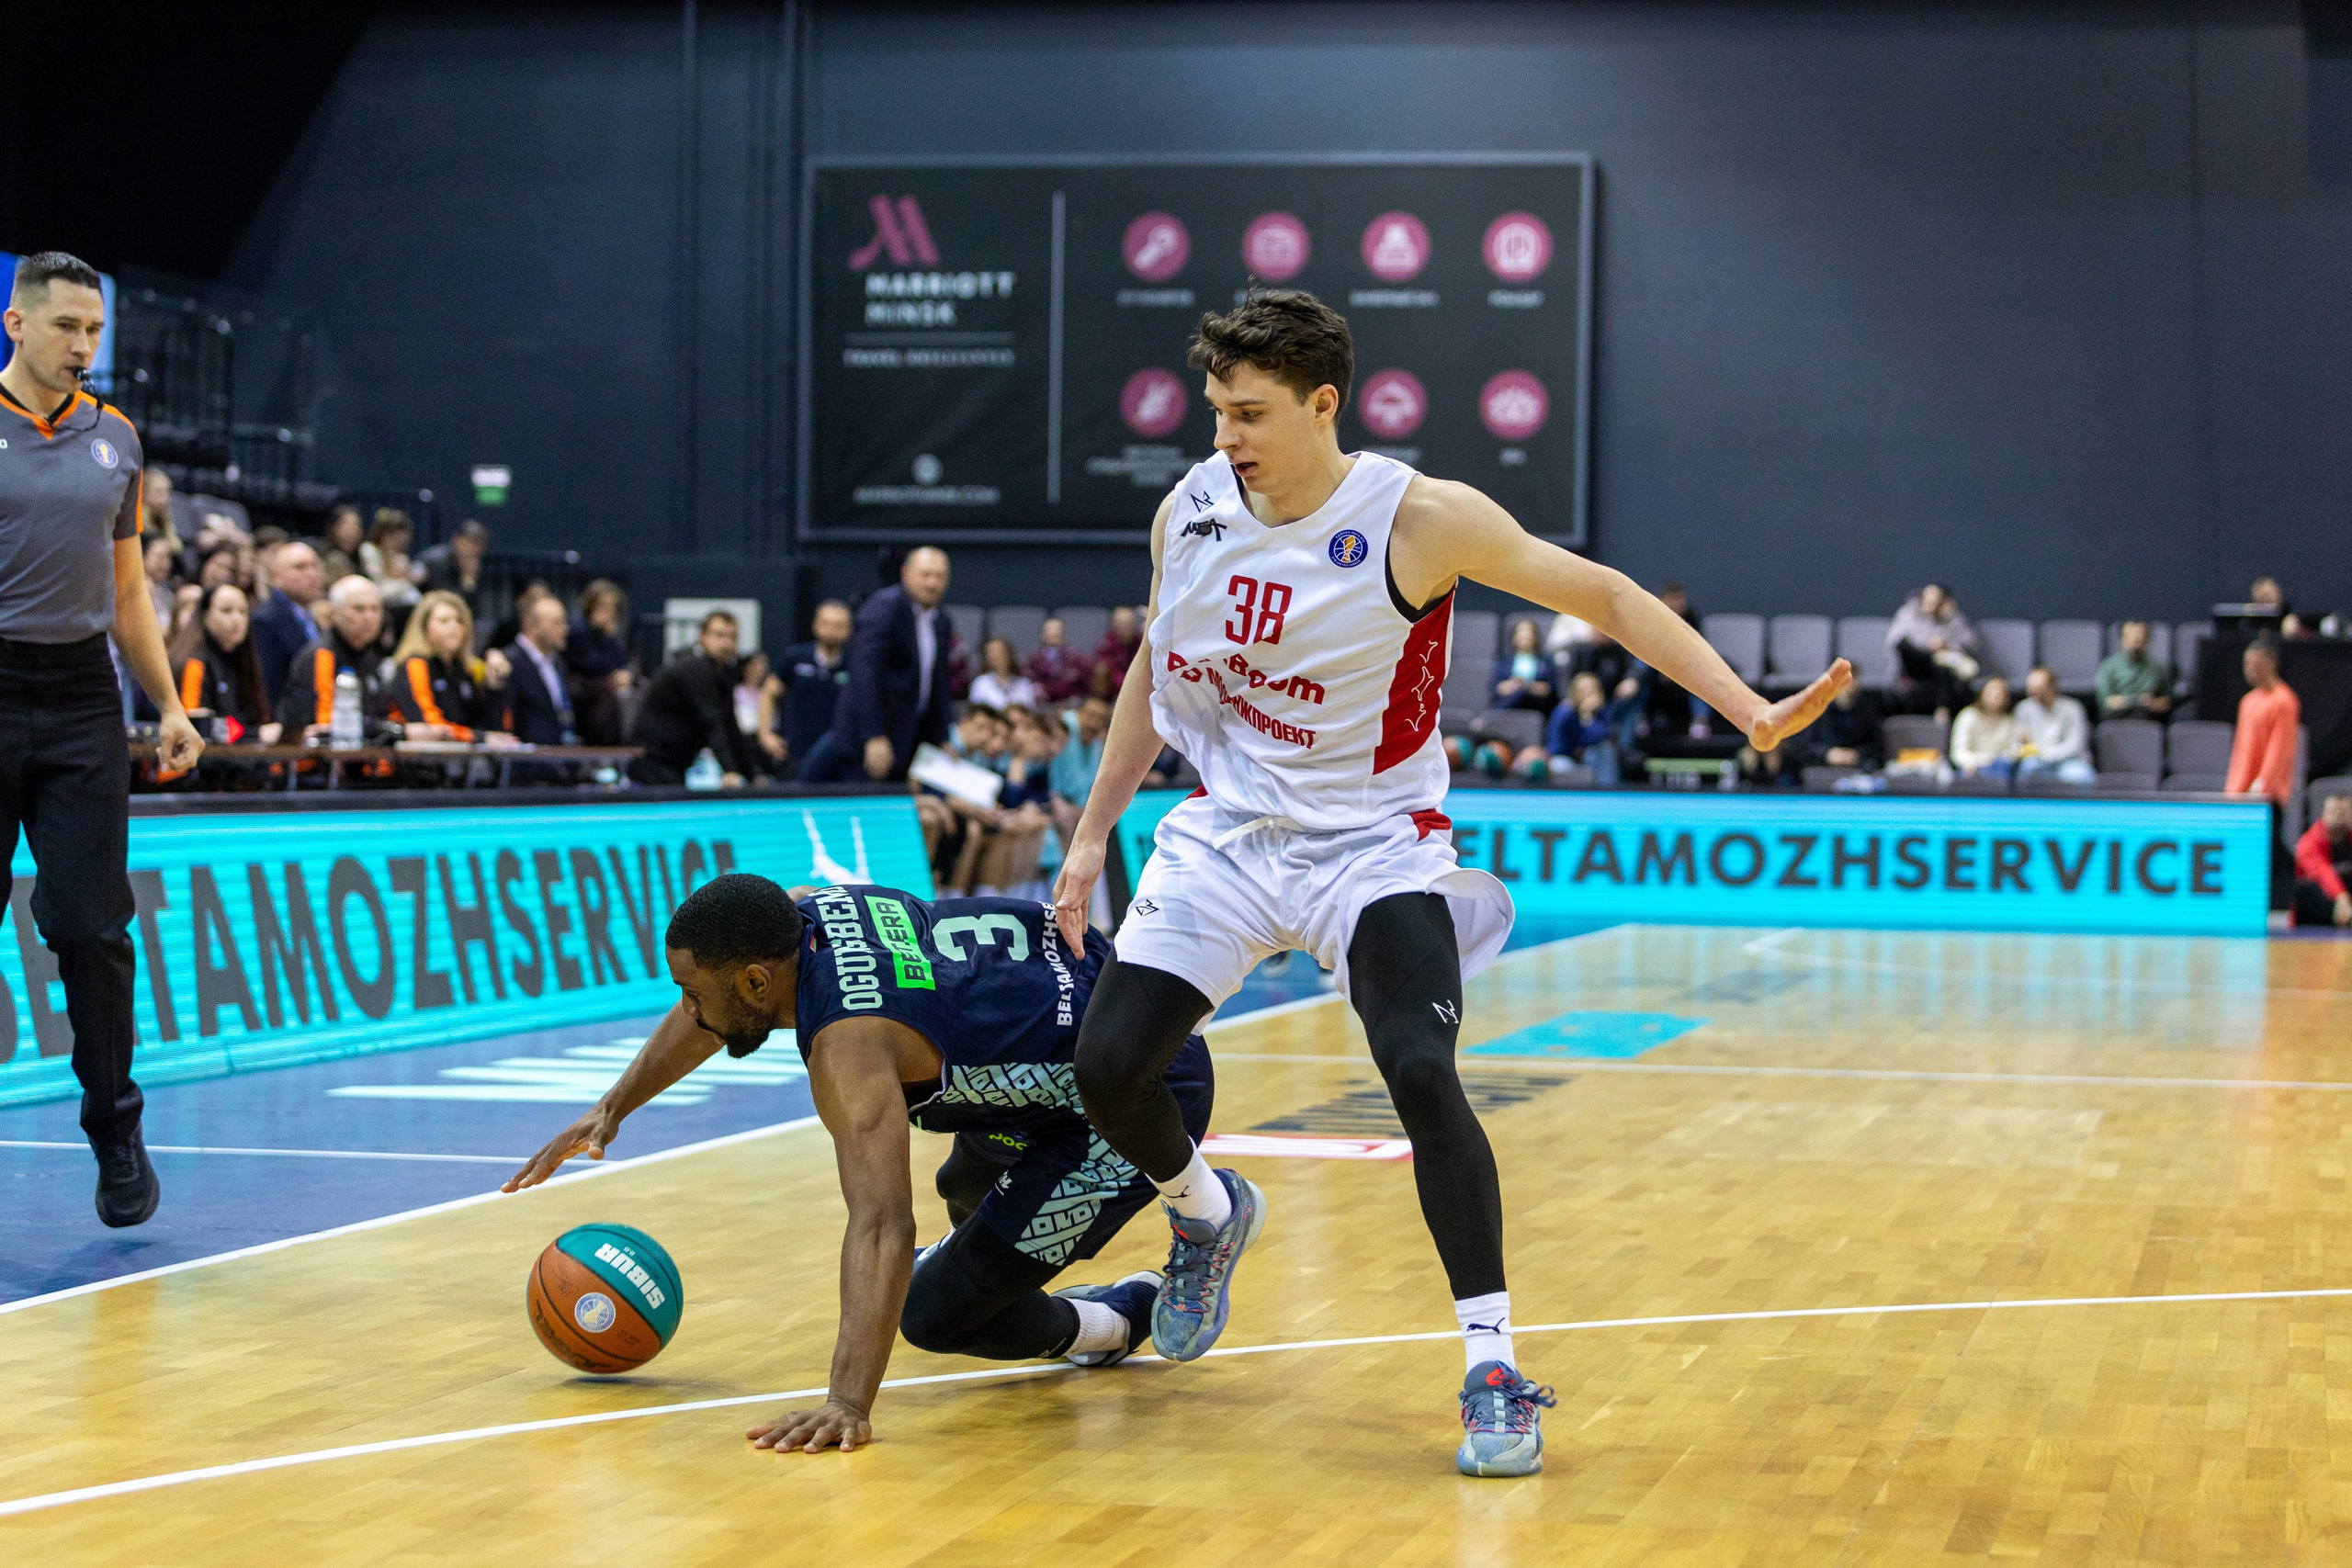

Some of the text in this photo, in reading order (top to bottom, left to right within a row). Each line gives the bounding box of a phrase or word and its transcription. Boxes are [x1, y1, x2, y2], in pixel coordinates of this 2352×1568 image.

[1225, 574, 1293, 646] 38
[1452, 829, 2223, 895] ELTAMOZHSERVICE
[931, 913, 1030, 962] 3
[1037, 901, 1075, 1027] BELTAMOZHSE
[594, 1242, 666, 1311] SIBUR
